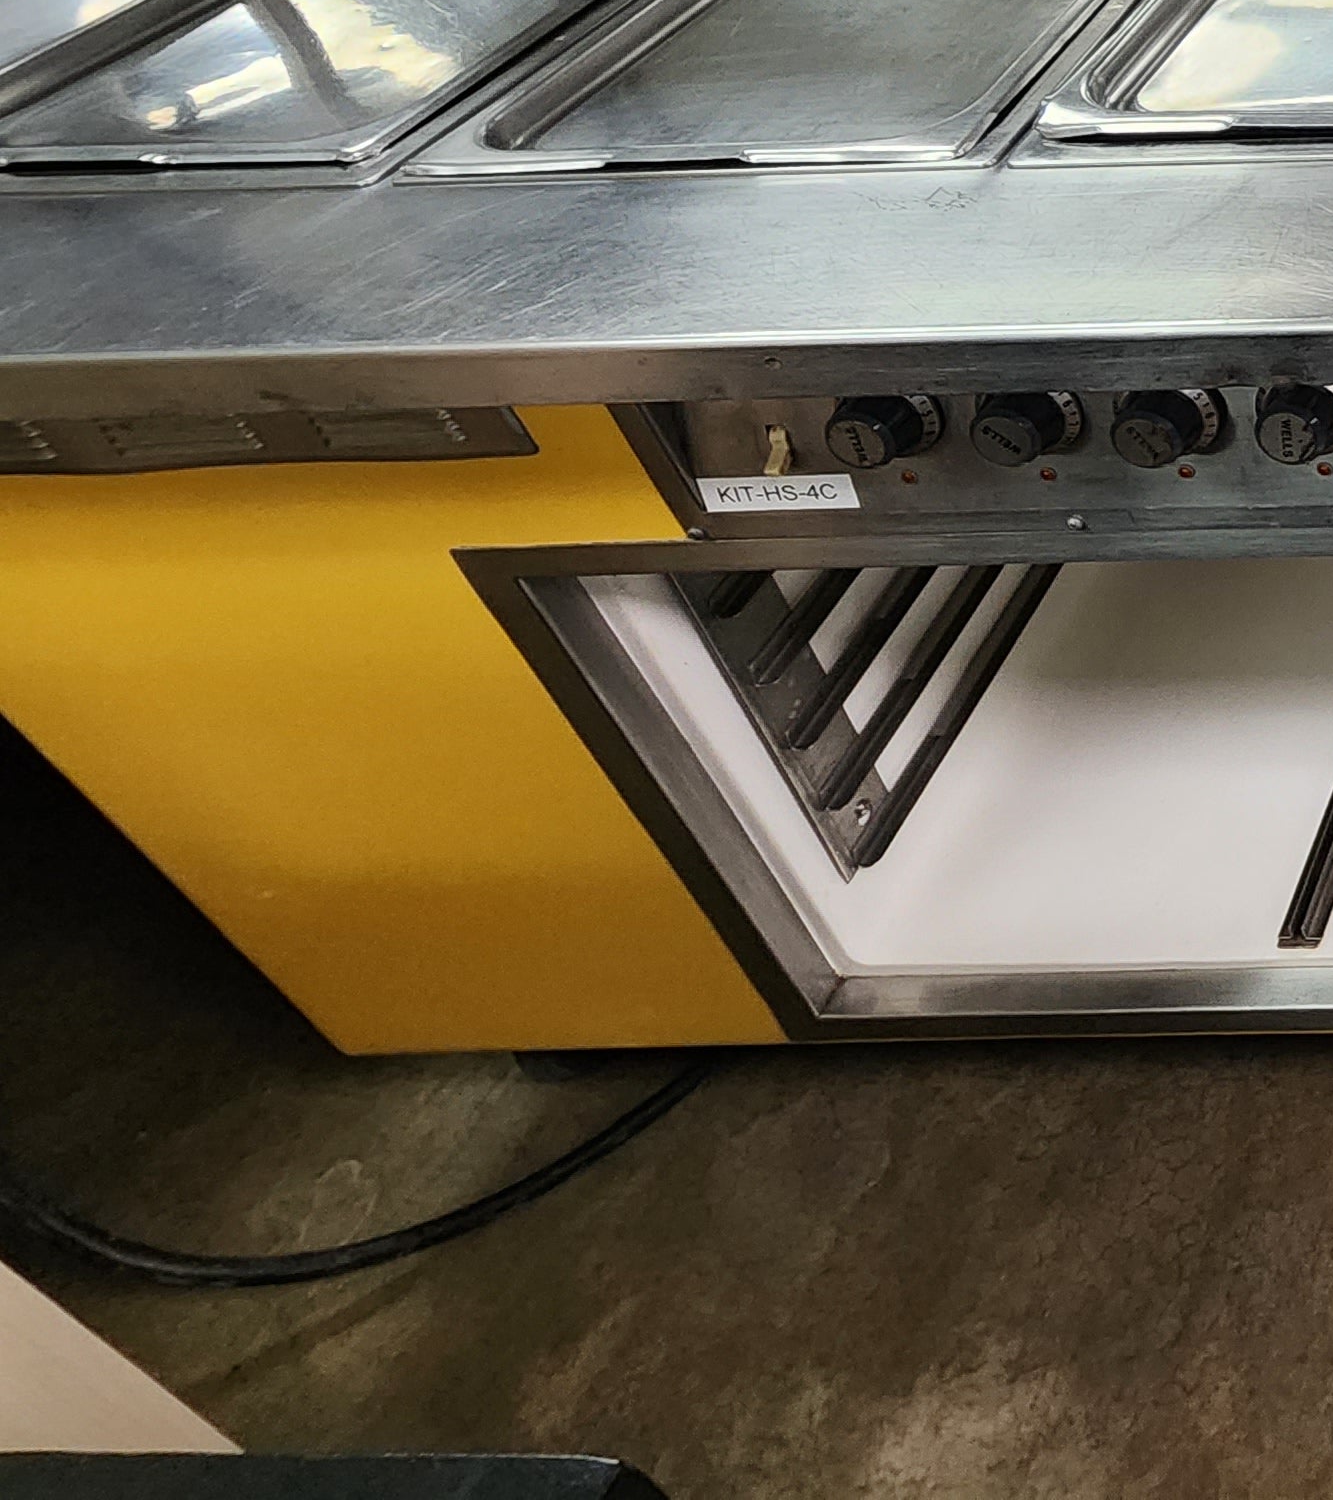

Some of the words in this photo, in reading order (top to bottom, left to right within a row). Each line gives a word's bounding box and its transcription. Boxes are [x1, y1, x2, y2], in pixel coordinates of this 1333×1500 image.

[981, 424, 1022, 455] WELLS
[1279, 419, 1294, 458] WELLS
[716, 483, 838, 503] KIT-HS-4C
